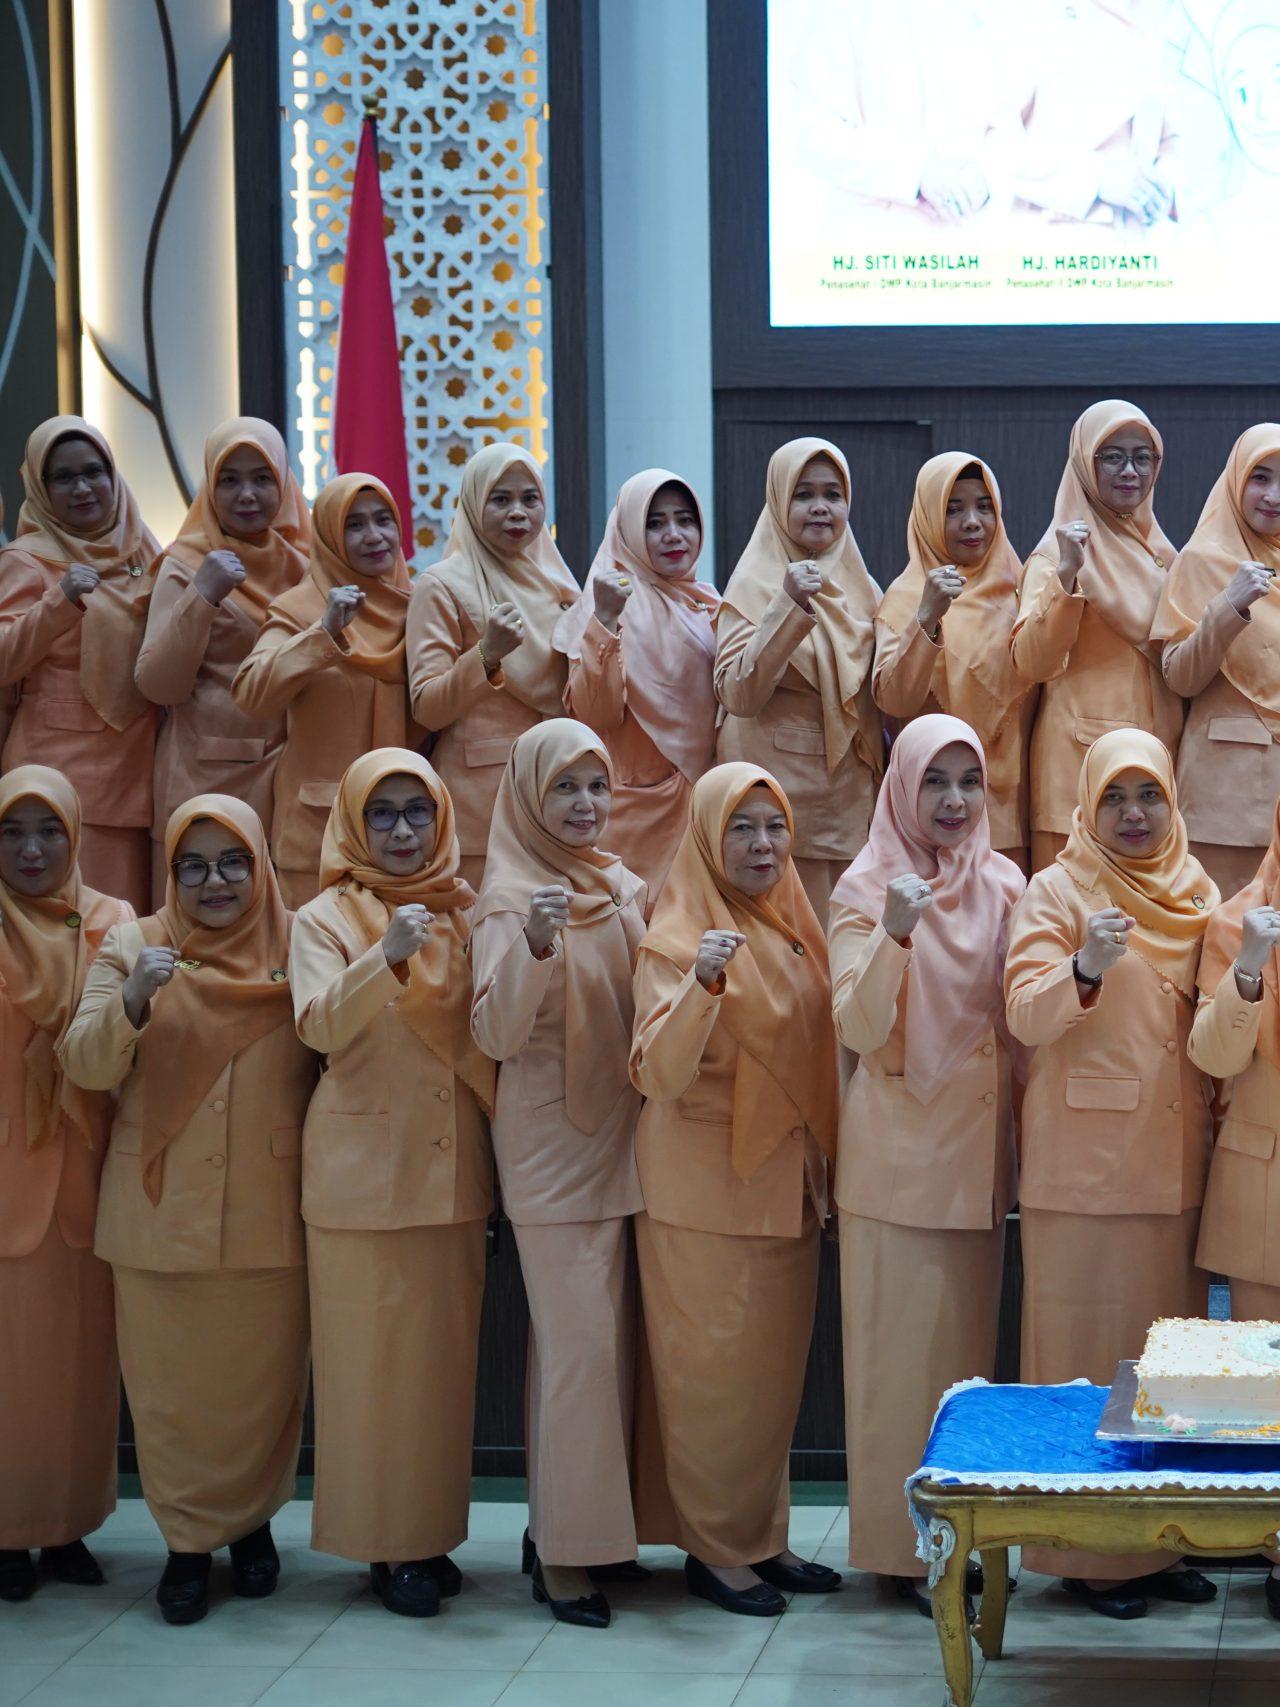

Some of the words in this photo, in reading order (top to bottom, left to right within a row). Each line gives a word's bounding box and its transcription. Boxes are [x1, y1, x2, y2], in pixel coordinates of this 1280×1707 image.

[832, 255, 858, 270] HJ.
[865, 255, 897, 270] SITI
[903, 255, 979, 270] WASILAH
[1022, 255, 1048, 270] HJ.
[1054, 255, 1158, 270] HARDIYANTI
